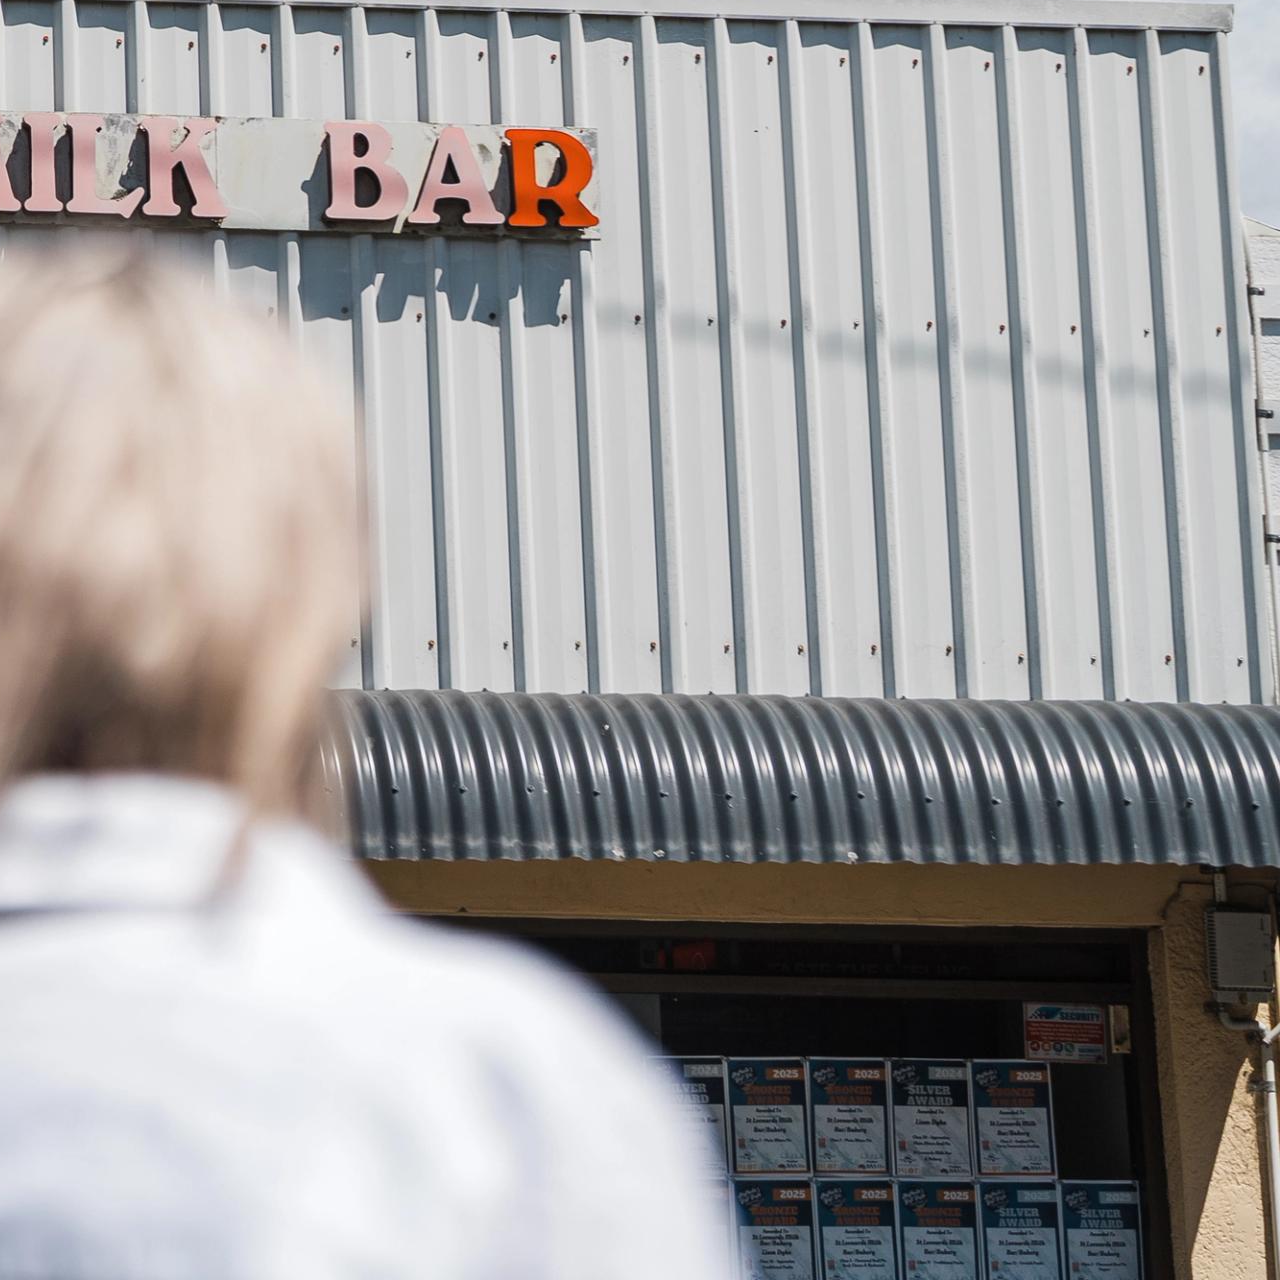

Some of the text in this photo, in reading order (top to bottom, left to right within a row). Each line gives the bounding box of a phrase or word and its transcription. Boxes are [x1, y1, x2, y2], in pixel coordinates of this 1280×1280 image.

[321, 121, 600, 228] BAR
[1060, 1012, 1100, 1021] SECURITY
[772, 1069, 798, 1079] 2025
[854, 1070, 880, 1079] 2025
[1016, 1072, 1042, 1081] 2025
[907, 1085, 951, 1095] SILVER
[907, 1096, 953, 1105] AWARD
[780, 1190, 806, 1199] 2025
[861, 1190, 888, 1199] 2025
[943, 1191, 969, 1200] 2025
[999, 1208, 1040, 1217] SILVER
[1080, 1209, 1122, 1218] SILVER
[999, 1218, 1042, 1227] AWARD
[1080, 1219, 1124, 1228] AWARD
